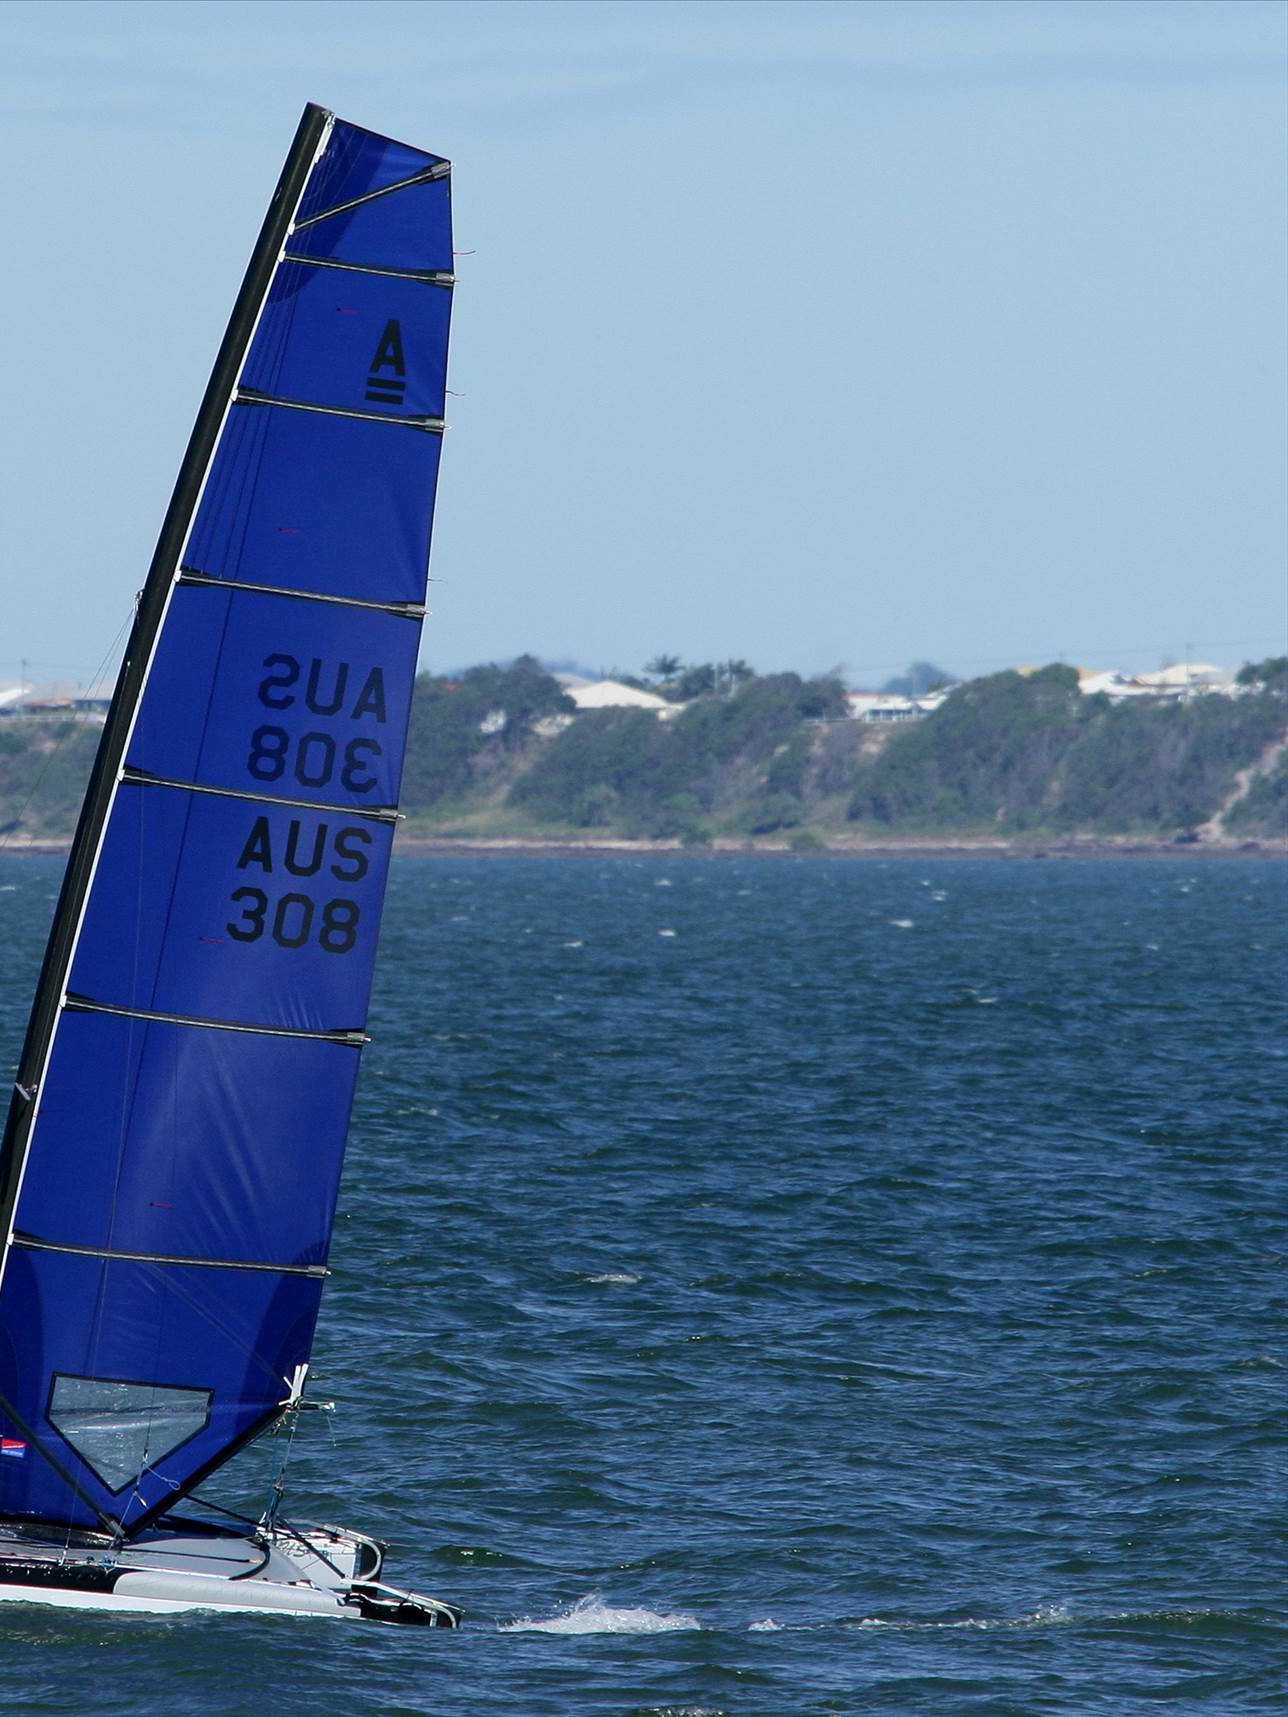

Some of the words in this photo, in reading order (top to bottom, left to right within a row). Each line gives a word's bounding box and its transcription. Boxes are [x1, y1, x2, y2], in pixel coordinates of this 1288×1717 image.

[369, 319, 406, 377] A
[236, 816, 373, 882] AUS
[226, 886, 361, 954] 308
